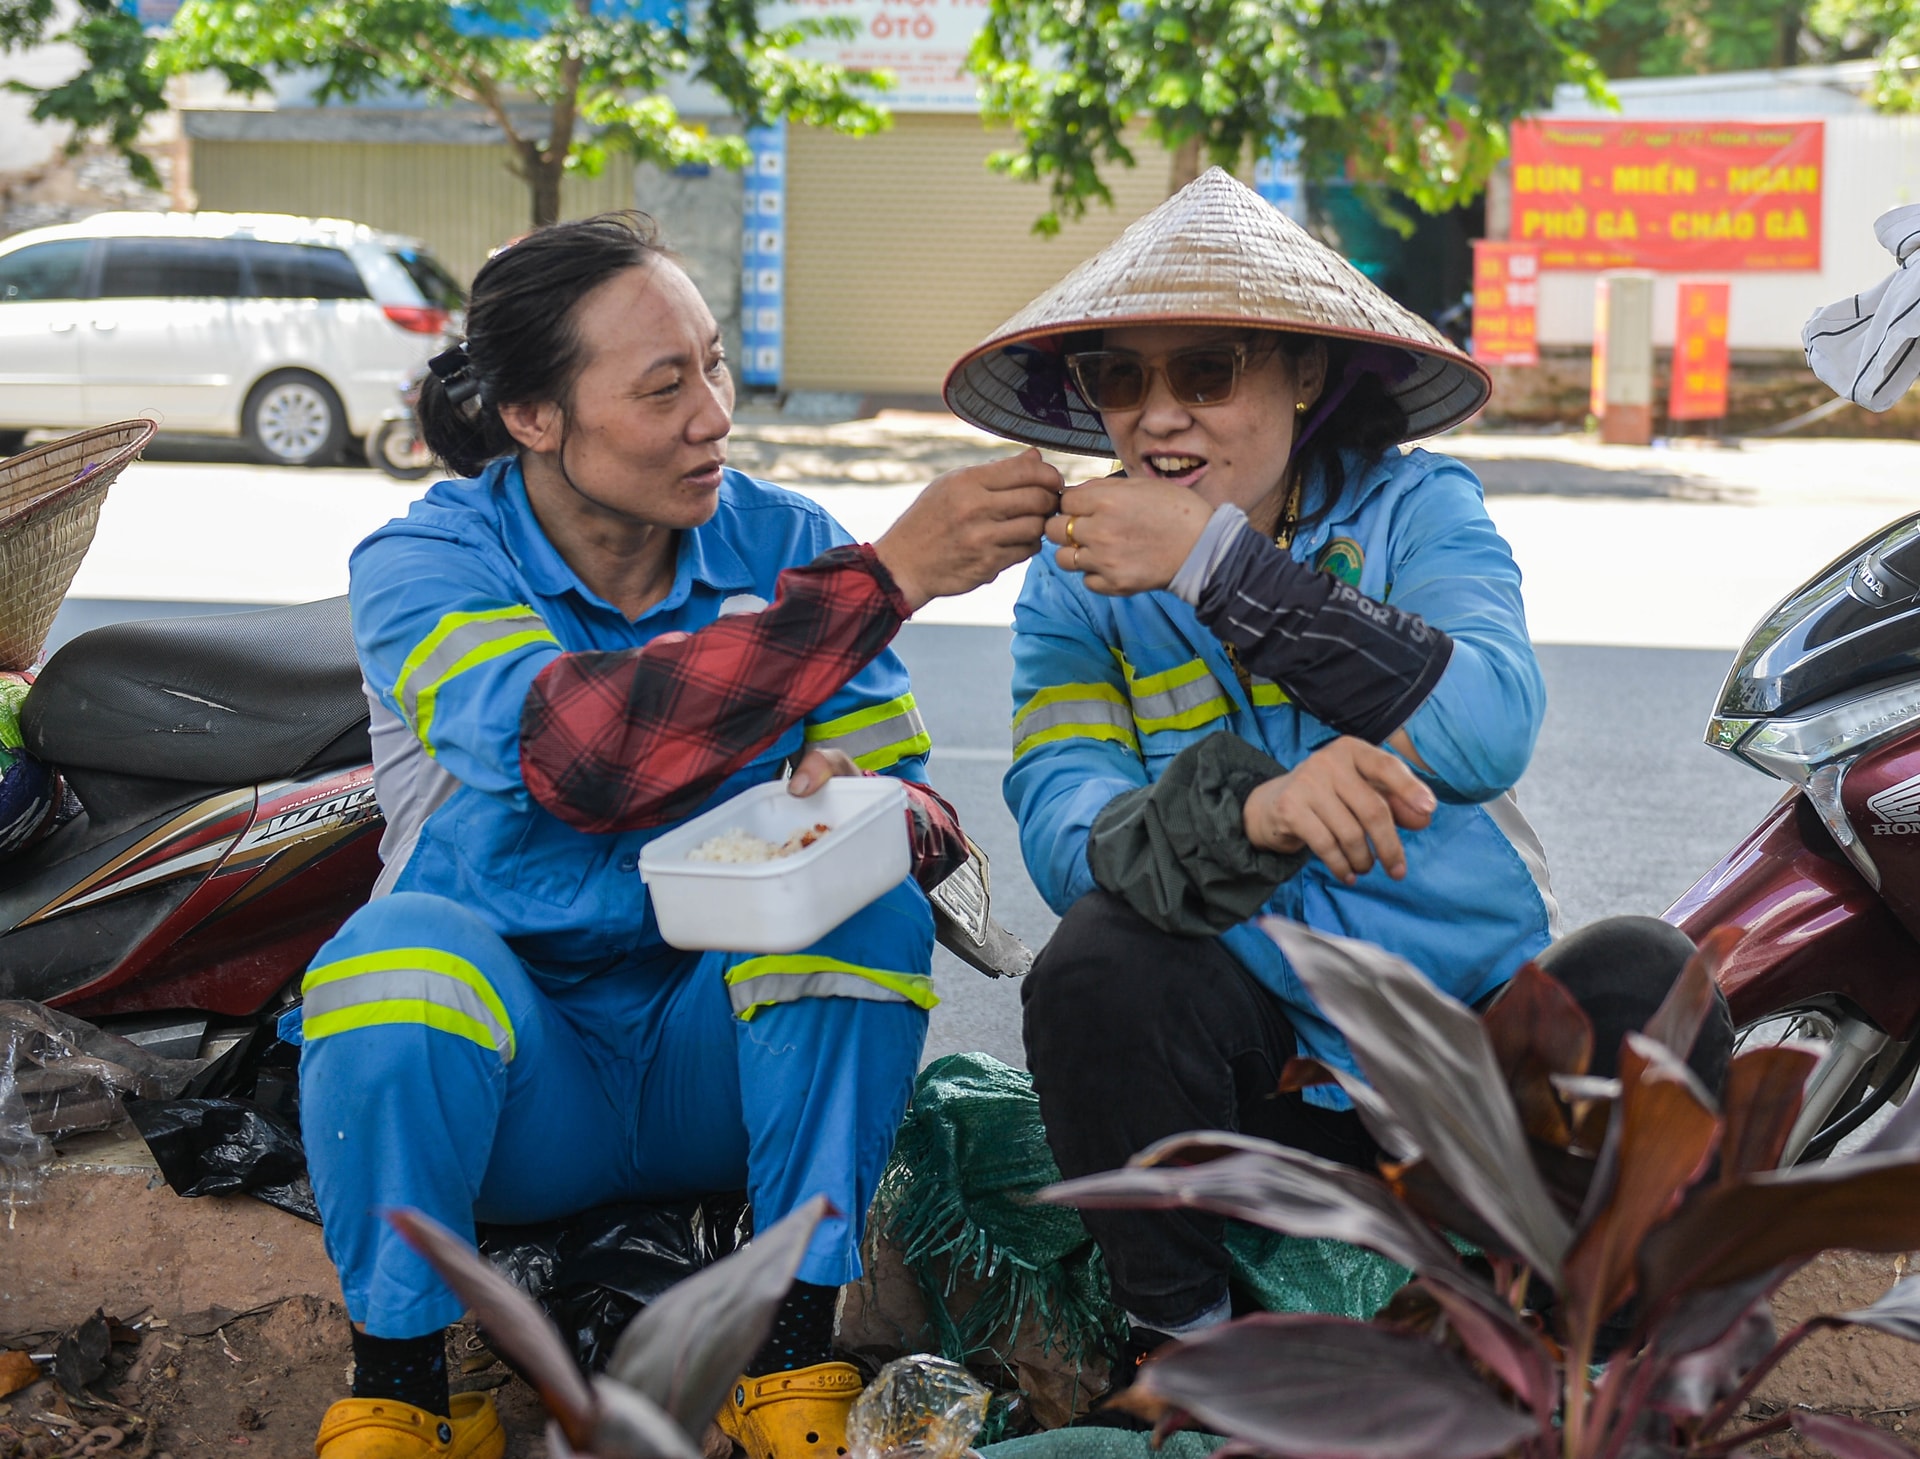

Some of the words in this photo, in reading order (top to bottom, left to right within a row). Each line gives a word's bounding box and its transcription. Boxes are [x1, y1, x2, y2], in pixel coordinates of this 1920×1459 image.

[870, 12, 935, 40] ÔTÔ
[1727, 165, 1818, 194] NGAN
[279, 788, 339, 812] SPLENDID
